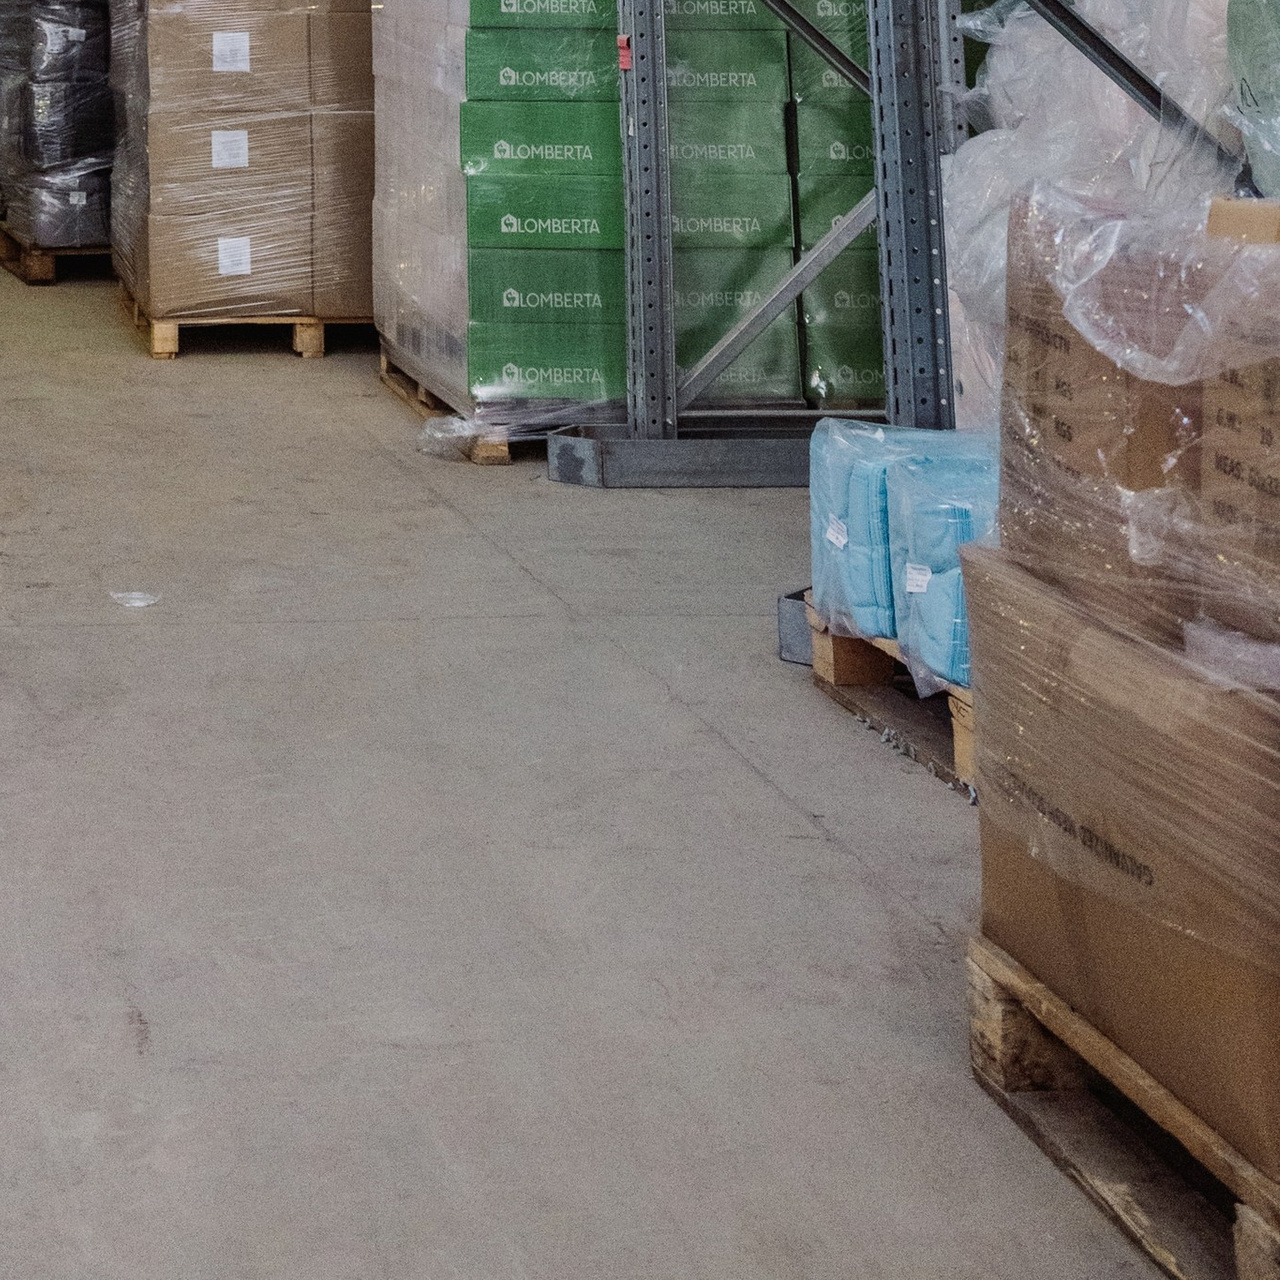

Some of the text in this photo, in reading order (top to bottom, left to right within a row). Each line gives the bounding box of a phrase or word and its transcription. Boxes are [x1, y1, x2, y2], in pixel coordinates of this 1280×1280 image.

[676, 0, 757, 15] LOMBERTA
[515, 70, 598, 88] LOMBERTA
[511, 144, 593, 160] LOMBERTA
[675, 145, 756, 160] LOMBERTA
[516, 217, 600, 234] LOMBERTA
[679, 218, 762, 233] LOMBERTA
[520, 291, 603, 309] LOMBERTA
[518, 366, 602, 384] LOMBERTA
